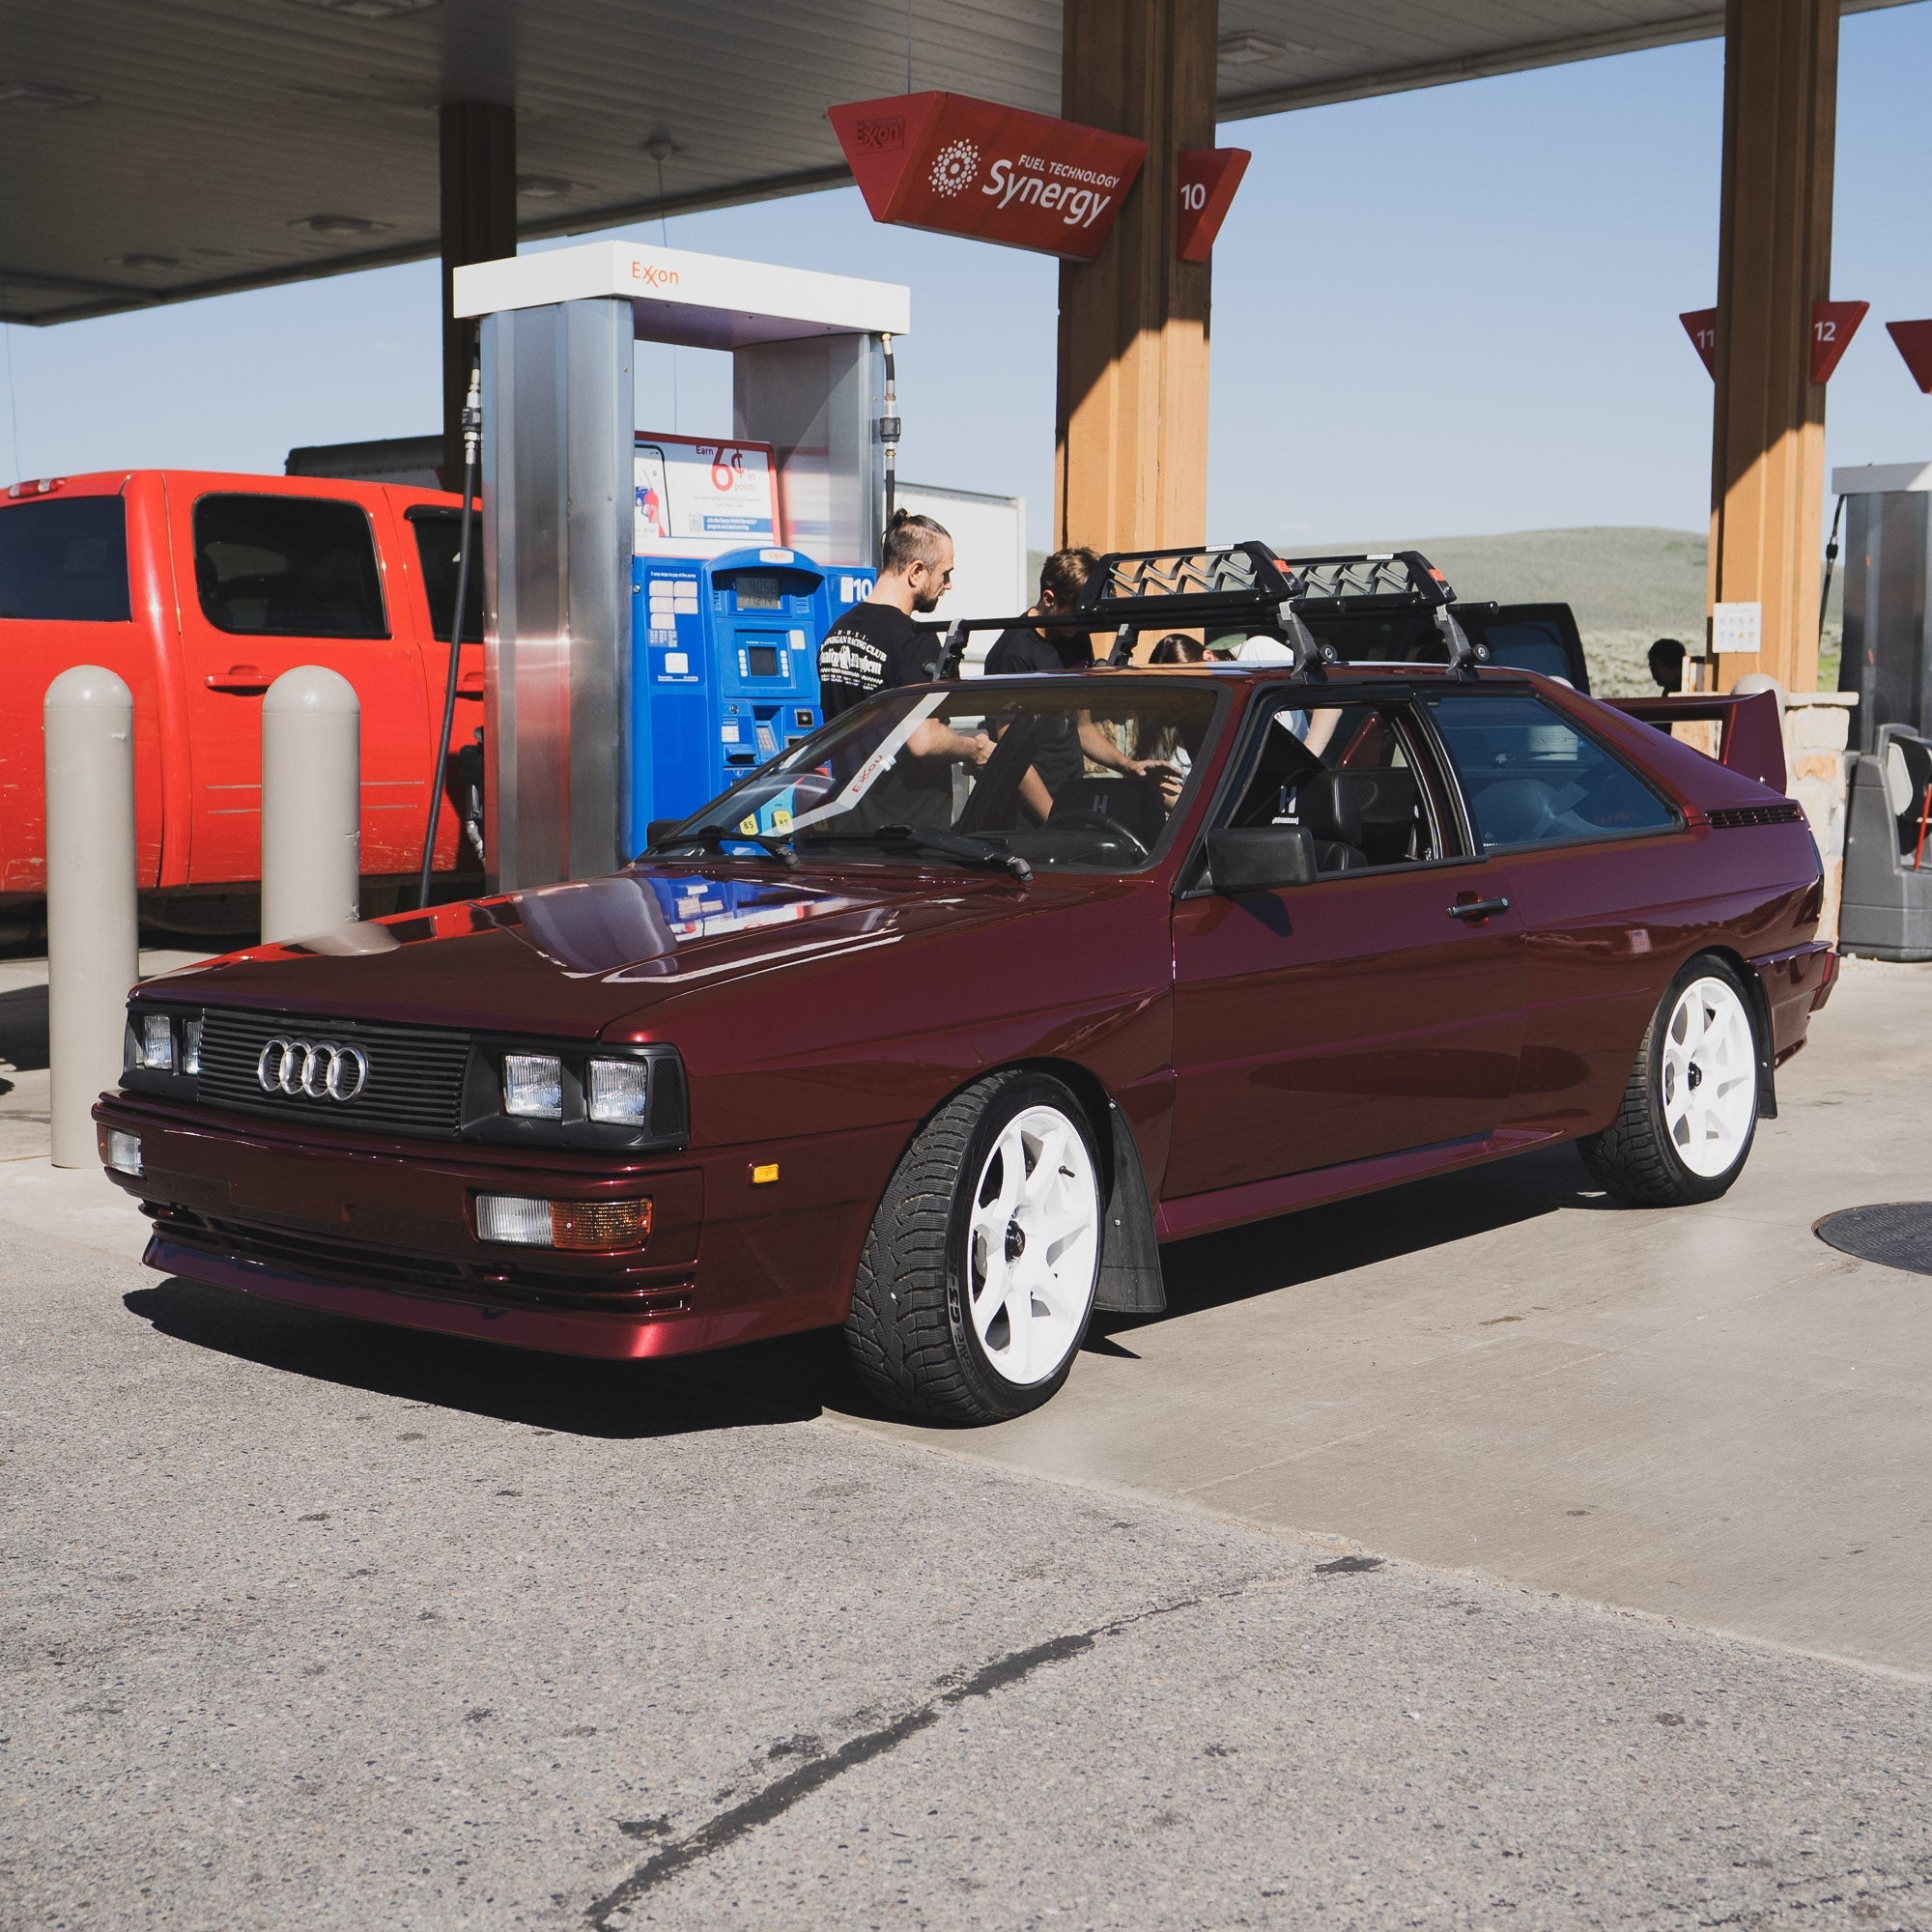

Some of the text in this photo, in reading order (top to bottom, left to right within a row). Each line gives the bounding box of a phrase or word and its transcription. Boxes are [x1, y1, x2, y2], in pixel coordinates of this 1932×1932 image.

[855, 121, 902, 149] Exxon
[1017, 154, 1120, 189] FUEL TECHNOLOGY
[981, 158, 1113, 228] Synergy
[1179, 182, 1207, 212] 10
[632, 260, 679, 288] Exxon
[1696, 328, 1715, 349] 11
[1813, 321, 1837, 342] 12
[696, 444, 714, 455] Earn
[748, 468, 756, 481] in
[734, 482, 757, 493] points
[853, 578, 873, 602] 10
[866, 644, 888, 663] CLUB
[743, 820, 754, 830] 85
